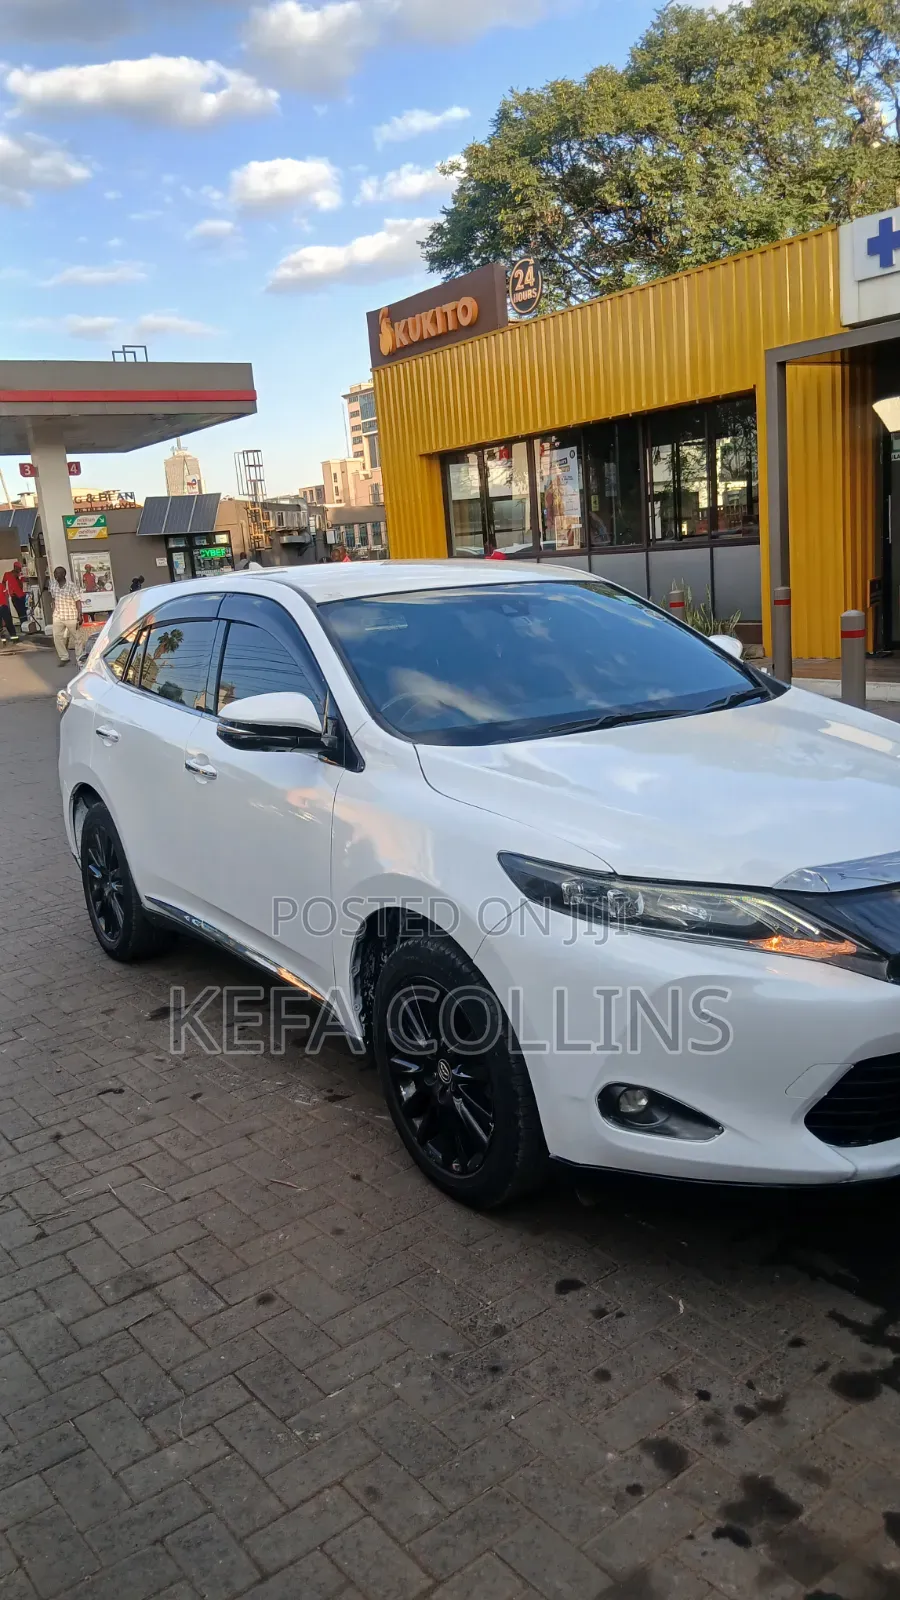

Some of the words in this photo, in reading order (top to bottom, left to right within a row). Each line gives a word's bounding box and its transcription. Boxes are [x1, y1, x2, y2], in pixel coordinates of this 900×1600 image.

[514, 265, 535, 291] 24
[513, 288, 537, 303] HOURS
[394, 296, 478, 349] KUKITO
[23, 464, 31, 476] 3
[70, 463, 78, 474] 4
[98, 491, 134, 502] BEAN
